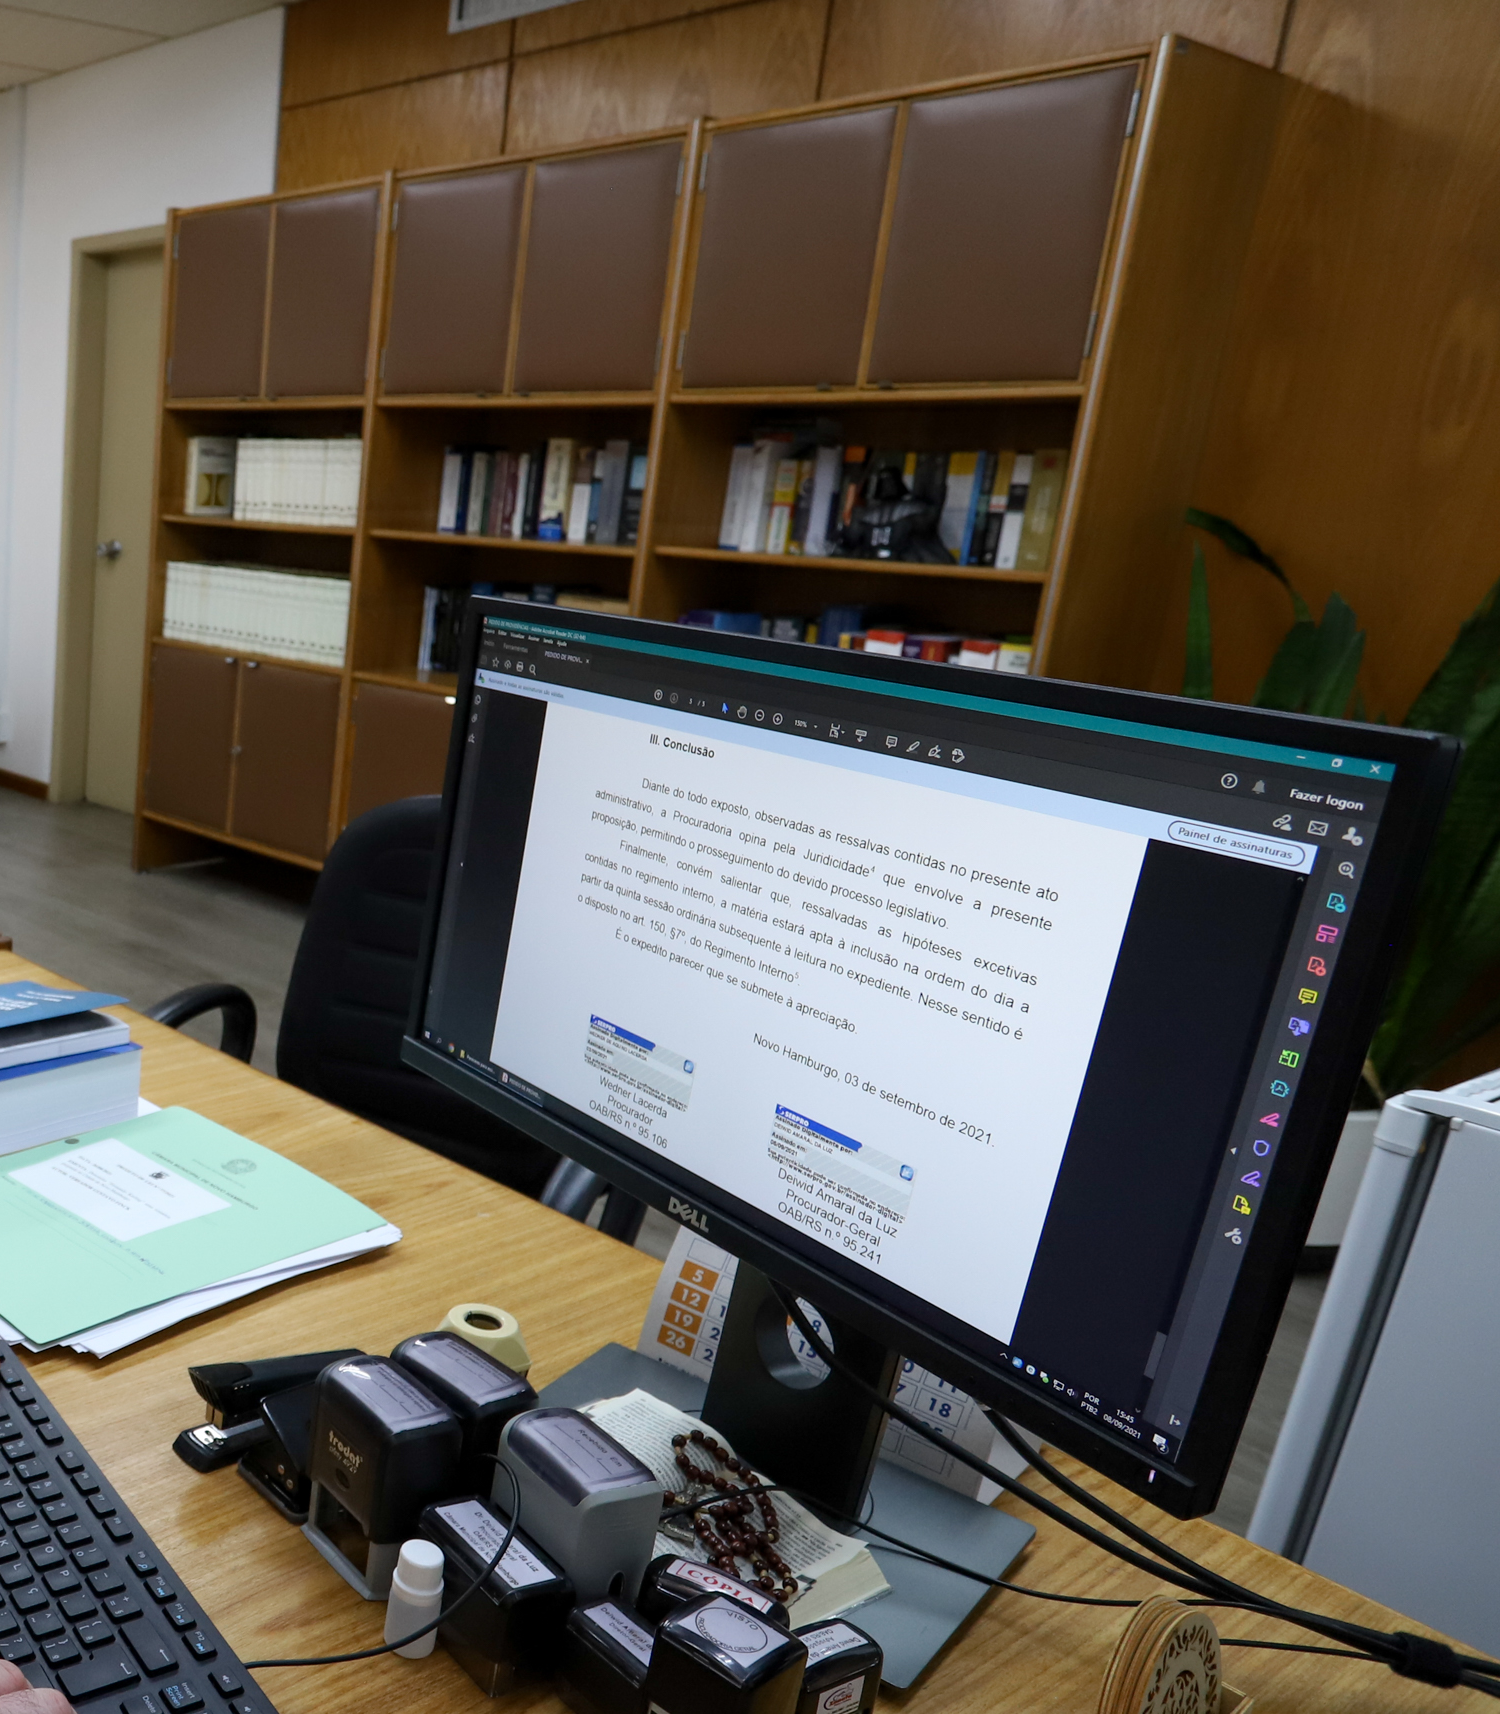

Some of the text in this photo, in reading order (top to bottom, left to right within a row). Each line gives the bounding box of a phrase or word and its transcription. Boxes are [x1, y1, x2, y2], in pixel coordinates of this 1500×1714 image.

[649, 733, 714, 758] III. Conclusão
[1289, 788, 1366, 814] Fazer logon
[641, 777, 1059, 902] Diante do todo exposto, observadas as ressalvas contidas no presente ato
[1177, 826, 1294, 860] Painel de assinaturas
[591, 810, 948, 929] proposição, permitindo o prosseguimento do devido processo legislativo.
[594, 790, 653, 816] administrativo,
[660, 808, 666, 818] a
[672, 809, 732, 837] Procuradoria
[738, 831, 766, 847] opina
[772, 841, 796, 856] pela
[882, 873, 905, 888] que
[914, 882, 963, 905] envolve
[972, 899, 982, 910] a
[990, 904, 1052, 931] presente
[619, 839, 1037, 986] Finalmente, convém salientar que, ressalvadas as hipóteses excetivas
[577, 894, 583, 902] o
[584, 895, 618, 916] disposto
[619, 909, 630, 920] no
[632, 914, 645, 926] art.
[650, 919, 666, 936] 150,
[689, 935, 702, 948] do
[703, 939, 756, 968] Regimento
[584, 852, 1030, 1014] contidas no regimento interno, a matéria estará apta à inclusão na ordem do dia a
[580, 873, 1023, 1040] partir da quinta sessão ordinária subsequente à leitura no expediente. Nesse sentido é
[615, 926, 857, 1034] É o expedito parecer que se submete à apreciação.
[599, 1074, 631, 1099] Wedner
[632, 1092, 667, 1118] Lacerda
[753, 1032, 994, 1147] Novo Hamburgo, 03 de setembro de 2021.
[588, 1099, 622, 1125] OAB/RS
[637, 1125, 667, 1149] 95.106
[607, 1094, 653, 1126] Procurador
[784, 1110, 809, 1127] SERPRO
[668, 1196, 709, 1232] DELL
[777, 1167, 898, 1238] Deiwid Amaral da Luz
[785, 1188, 881, 1247] Procurador-Geral
[777, 1201, 822, 1233] OAB/RS
[842, 1235, 881, 1264] 95.241
[692, 1270, 703, 1282] 5
[682, 1289, 701, 1308] 12
[674, 1310, 694, 1327] 19
[665, 1331, 686, 1349] 26
[929, 1397, 952, 1418] 18
[1080, 1400, 1098, 1416] PTB2
[1083, 1391, 1100, 1406] POR
[1102, 1412, 1141, 1440] 08/09/2021
[1115, 1408, 1135, 1424] 15:45
[329, 1430, 360, 1468] trodat
[578, 1429, 622, 1467] Recebido Em
[156, 1576, 166, 1586] F10
[688, 1570, 754, 1606] CÓPIA
[174, 1603, 184, 1612] F11
[726, 1611, 758, 1630] VISTO
[195, 1631, 204, 1642] F12
[142, 1694, 157, 1714] Delete
[166, 1687, 181, 1707] Screen
[172, 1685, 184, 1700] Print
[182, 1682, 196, 1699] Insert
